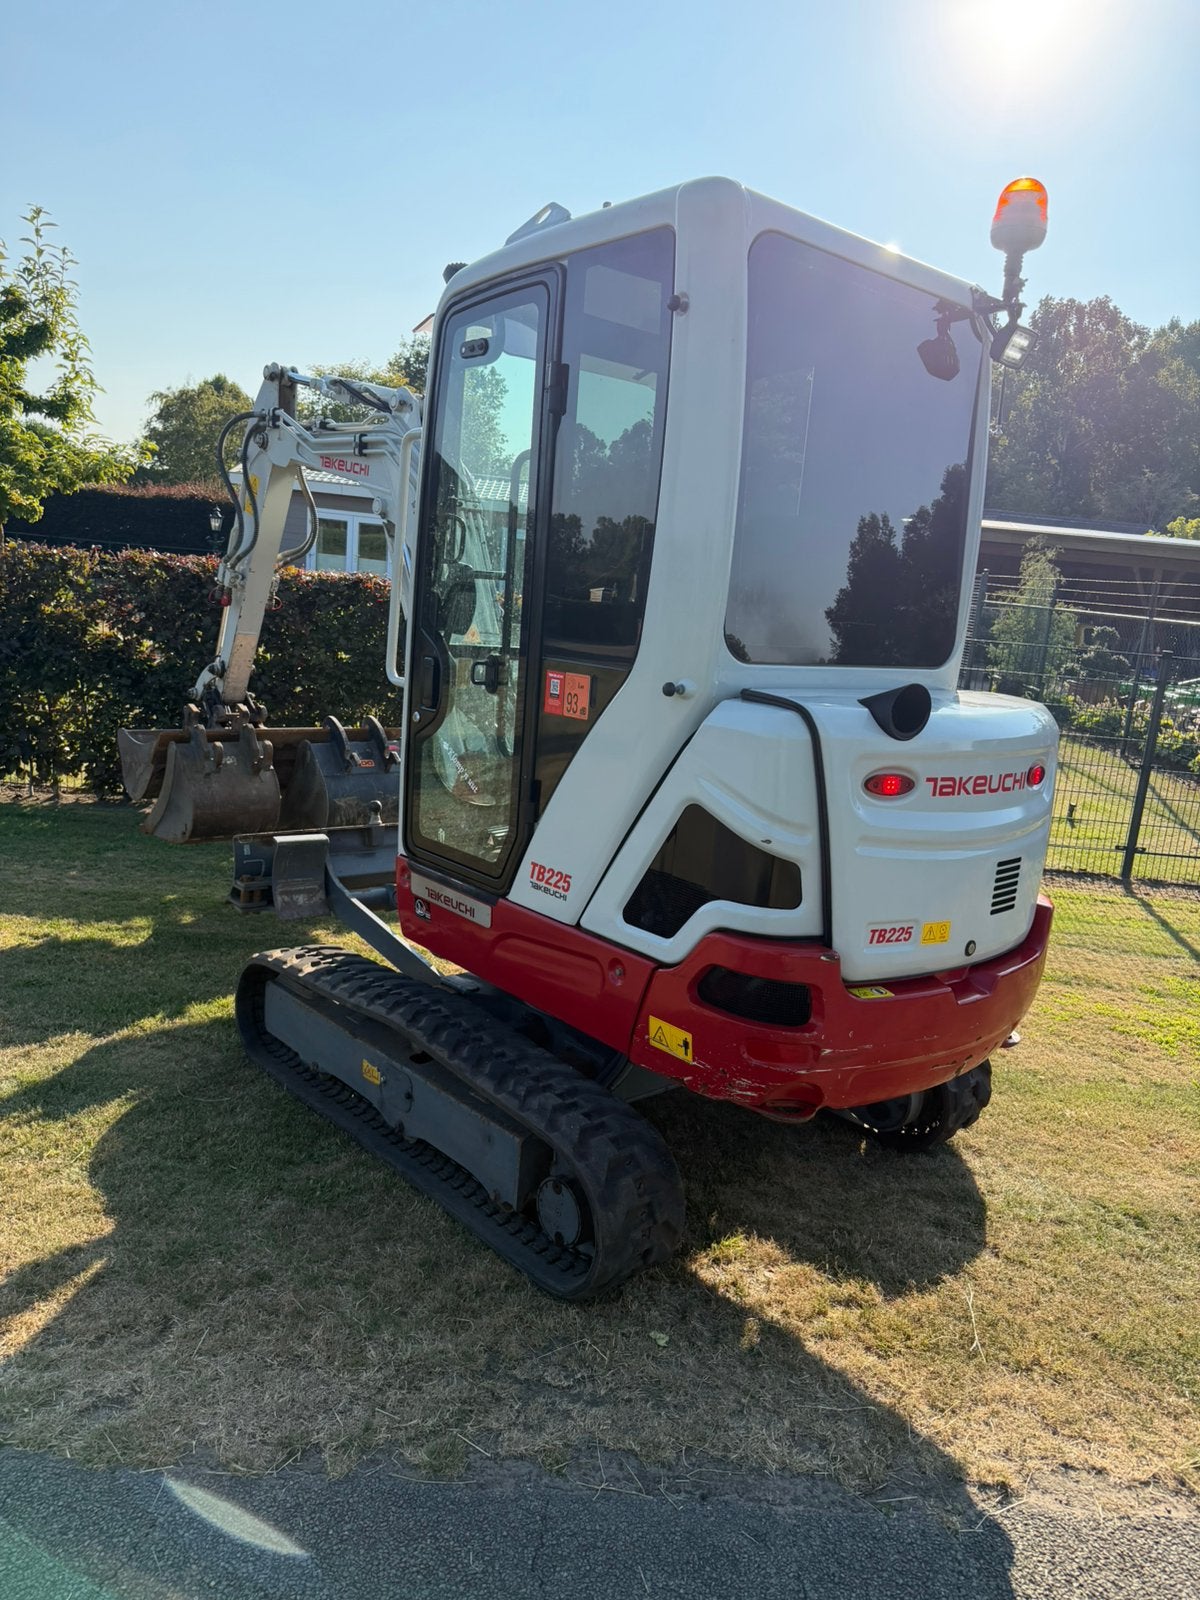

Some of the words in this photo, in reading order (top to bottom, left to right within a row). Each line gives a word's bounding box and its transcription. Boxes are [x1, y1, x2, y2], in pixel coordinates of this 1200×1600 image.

[319, 455, 370, 476] TAKEUCHI
[566, 691, 579, 714] 93
[924, 771, 1027, 797] TAKEUCHI
[529, 861, 573, 893] TB225
[425, 886, 476, 919] TAKEUCHI
[529, 880, 568, 902] TAKEUCHI
[868, 926, 914, 945] TB225
